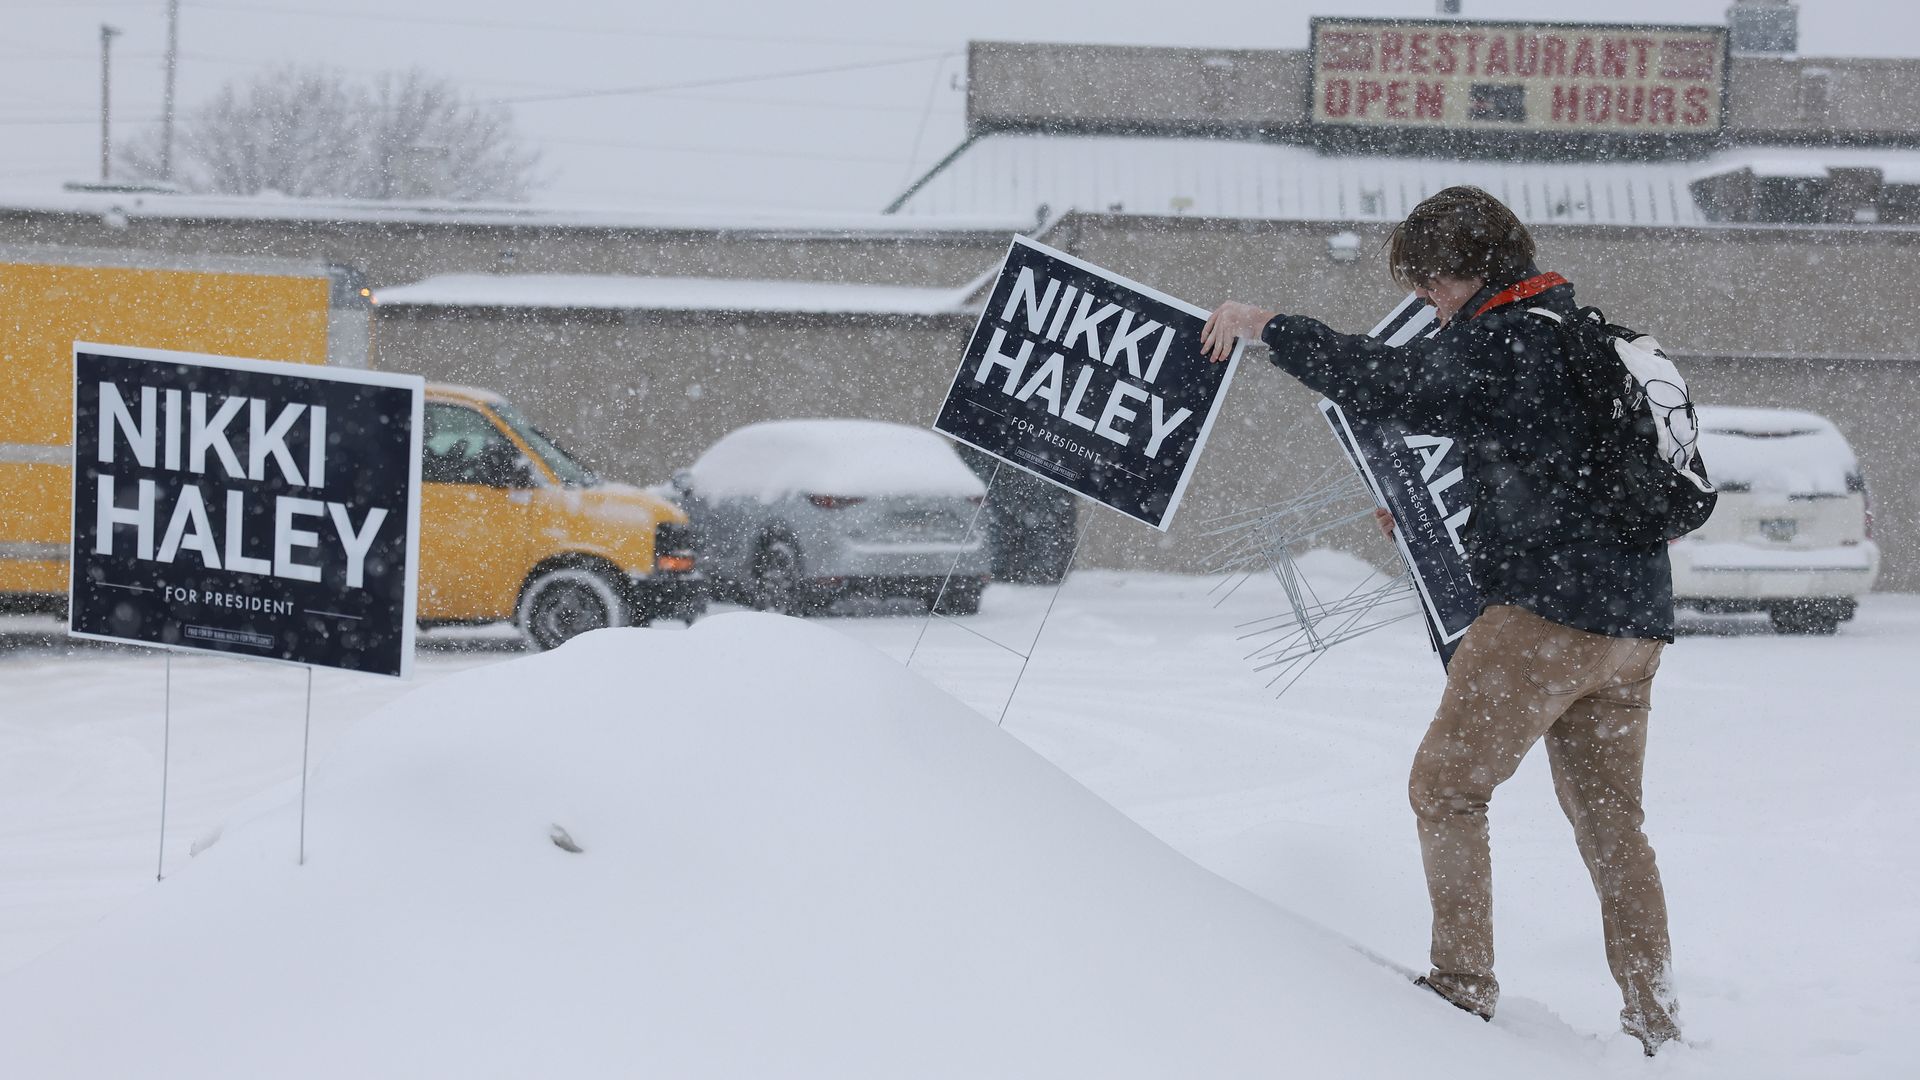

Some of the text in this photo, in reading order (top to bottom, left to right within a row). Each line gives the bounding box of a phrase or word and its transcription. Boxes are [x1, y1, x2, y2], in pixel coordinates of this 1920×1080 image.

[1324, 78, 1710, 125] OPEN HOURS
[1380, 30, 1656, 79] RESTAURANT
[1001, 266, 1176, 384] NIKKI
[98, 381, 327, 488] NIKKI
[974, 327, 1193, 459] HALEY
[1011, 416, 1101, 463] FOR PRESIDENT
[96, 473, 389, 589] HALEY
[1390, 451, 1409, 477] FOR
[1404, 479, 1439, 545] PRESIDENT
[165, 586, 294, 616] FOR PRESIDENT
